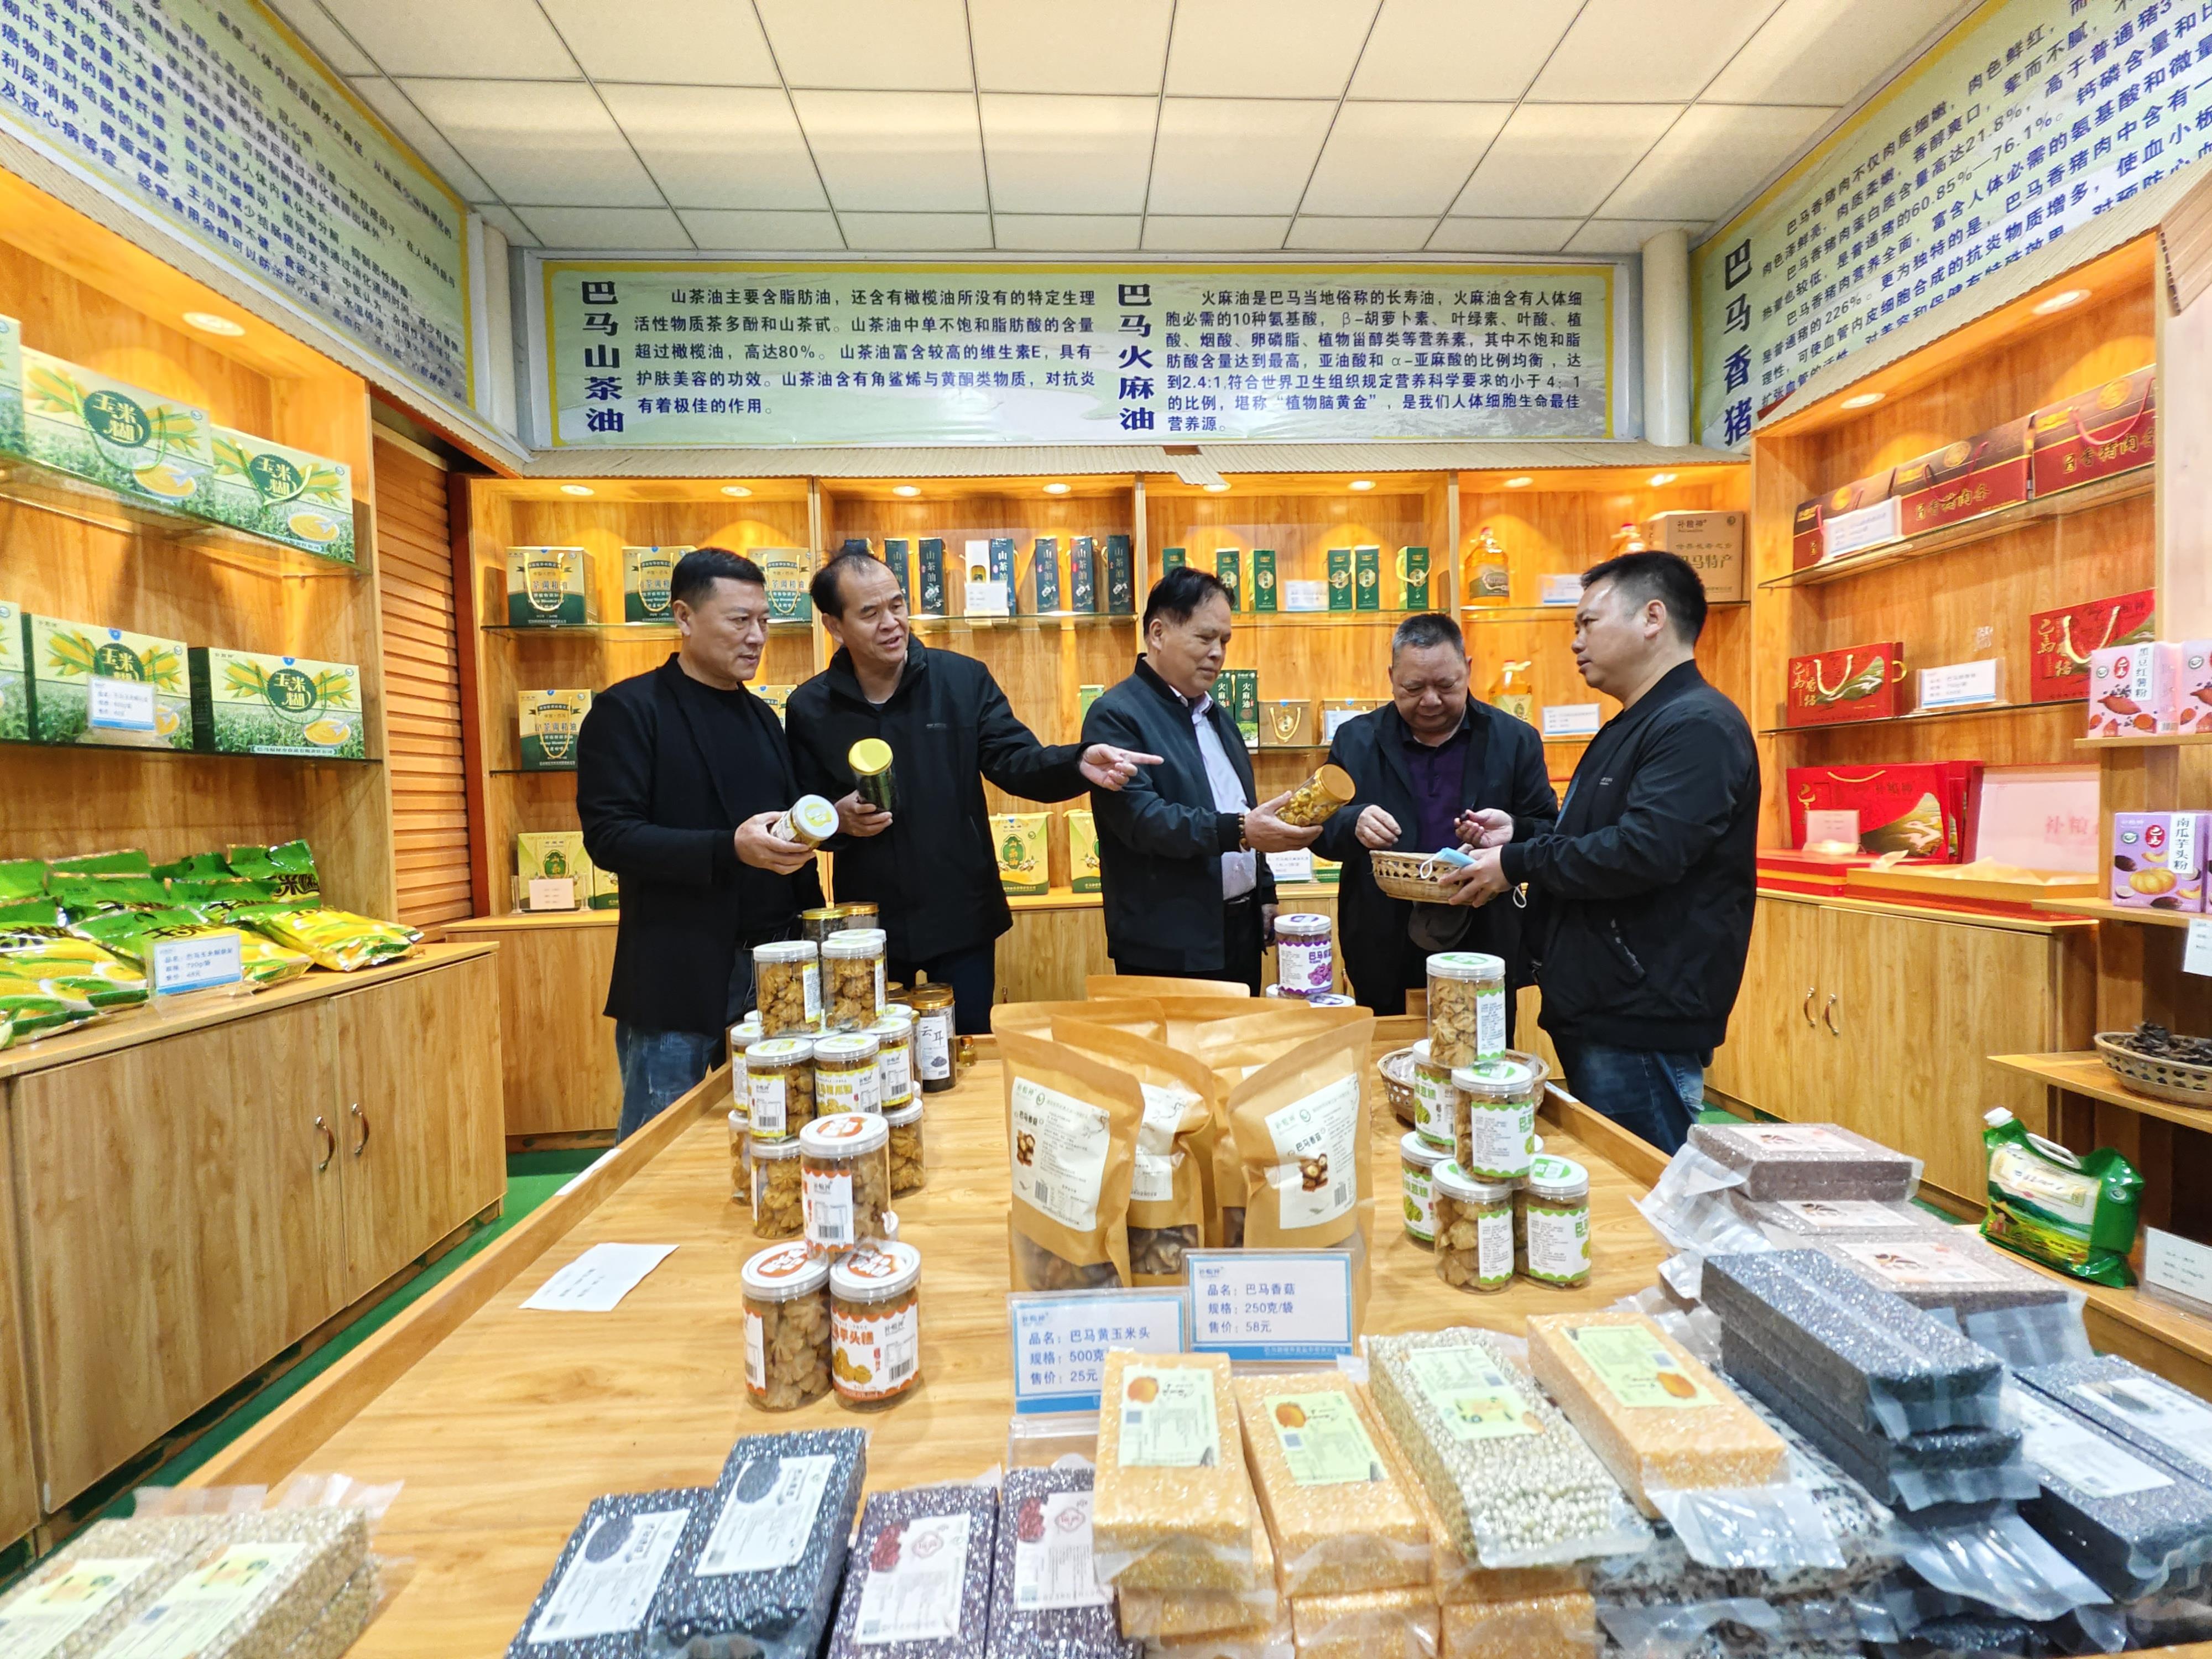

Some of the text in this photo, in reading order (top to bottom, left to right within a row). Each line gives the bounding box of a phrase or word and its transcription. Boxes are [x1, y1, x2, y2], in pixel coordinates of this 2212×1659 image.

[671, 288, 1096, 307] 山茶油主要含脂肪油，还含有橄榄油所没有的特定生理
[1201, 289, 1583, 307] 火麻油是巴马当地俗称的长寿油，火麻油含有人体细
[1723, 239, 1752, 448] 巴马香猪
[581, 279, 624, 435] 巴马山茶油
[1117, 283, 1155, 432] 巴马火麻油
[638, 397, 773, 416] 有着极佳的作用。
[1168, 415, 1228, 432] 营养源。
[2135, 646, 2150, 698] 黑豆红薯粉
[1242, 682, 1251, 708] 火麻油
[2045, 815, 2100, 835] 补粮
[2174, 817, 2190, 871] 南瓜芋头粉
[920, 1026, 944, 1045] 云耳
[1019, 1110, 1039, 1127] 巴马香菇
[1295, 1131, 1323, 1151] 巴马香菇
[1207, 1282, 1296, 1297] 品名：巴马香菇
[1208, 1301, 1294, 1316] 规格：250克/袋
[1029, 1326, 1151, 1346] 品名：巴马黄玉米头
[1209, 1320, 1272, 1334] 售价：58元
[1030, 1348, 1109, 1366] 规格：500克
[1030, 1369, 1098, 1386] 售价：25元
